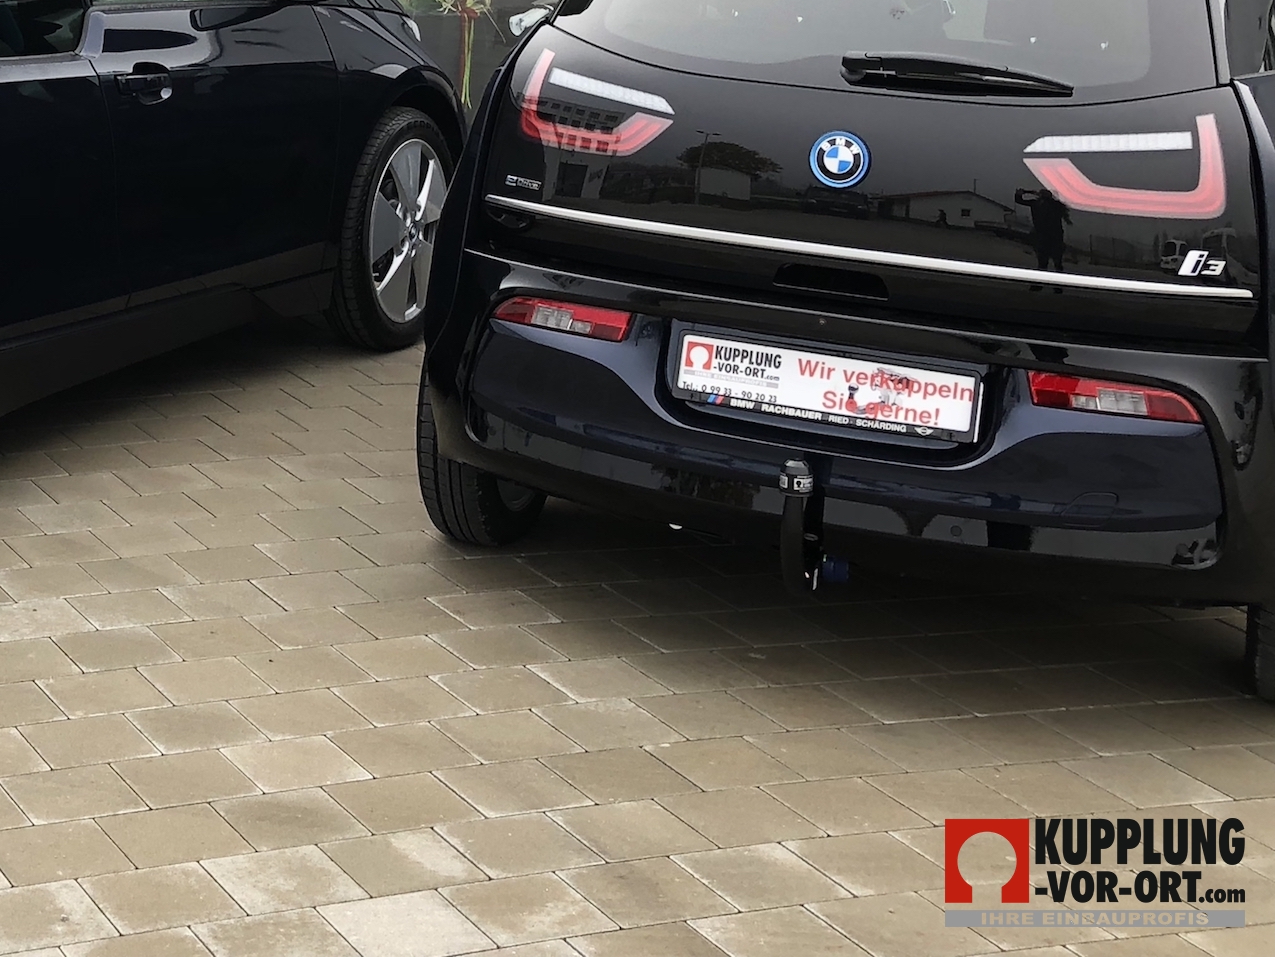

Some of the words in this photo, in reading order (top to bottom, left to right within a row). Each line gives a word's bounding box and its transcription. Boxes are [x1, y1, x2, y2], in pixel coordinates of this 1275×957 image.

[713, 362, 780, 381] -VOR-ORT.com
[714, 345, 782, 370] KUPPLUNG
[797, 357, 836, 381] Wir
[843, 369, 974, 403] verkuppeln
[729, 398, 756, 410] BMW
[761, 402, 823, 420] RACHBAUER
[828, 414, 849, 425] RIED
[855, 419, 908, 434] SCHÄRDING
[822, 390, 858, 413] Sie
[865, 401, 941, 426] gerne!
